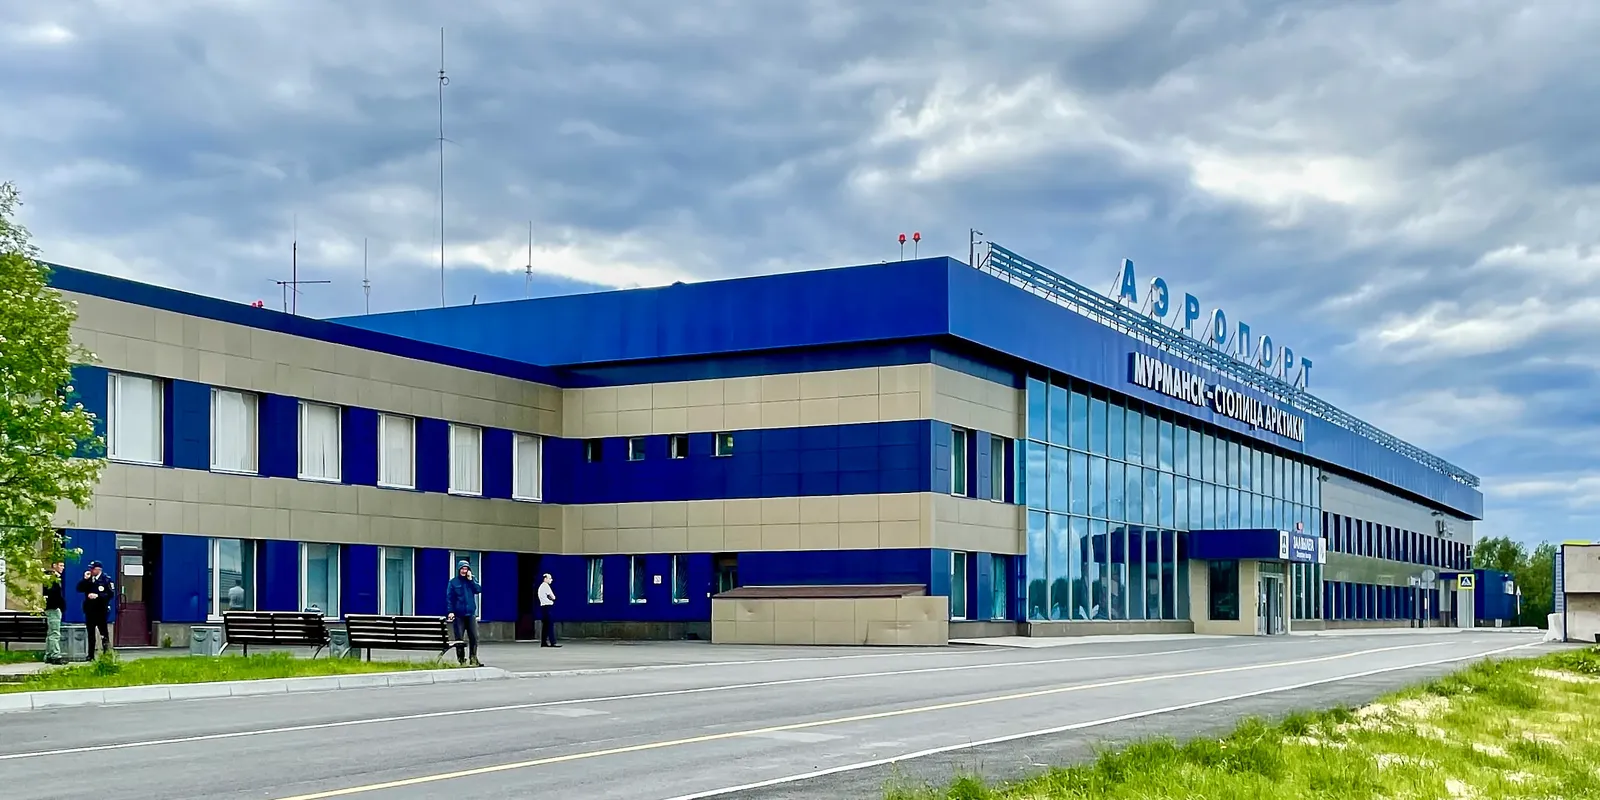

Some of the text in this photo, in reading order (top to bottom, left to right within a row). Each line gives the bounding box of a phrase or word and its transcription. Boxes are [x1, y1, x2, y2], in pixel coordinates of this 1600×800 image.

[1120, 258, 1312, 387] АЭРОПОРТ
[1134, 352, 1206, 407] МУРМАНСК
[1214, 383, 1264, 431] СТОЛИЦА
[1265, 405, 1305, 442] АРКТИКИ
